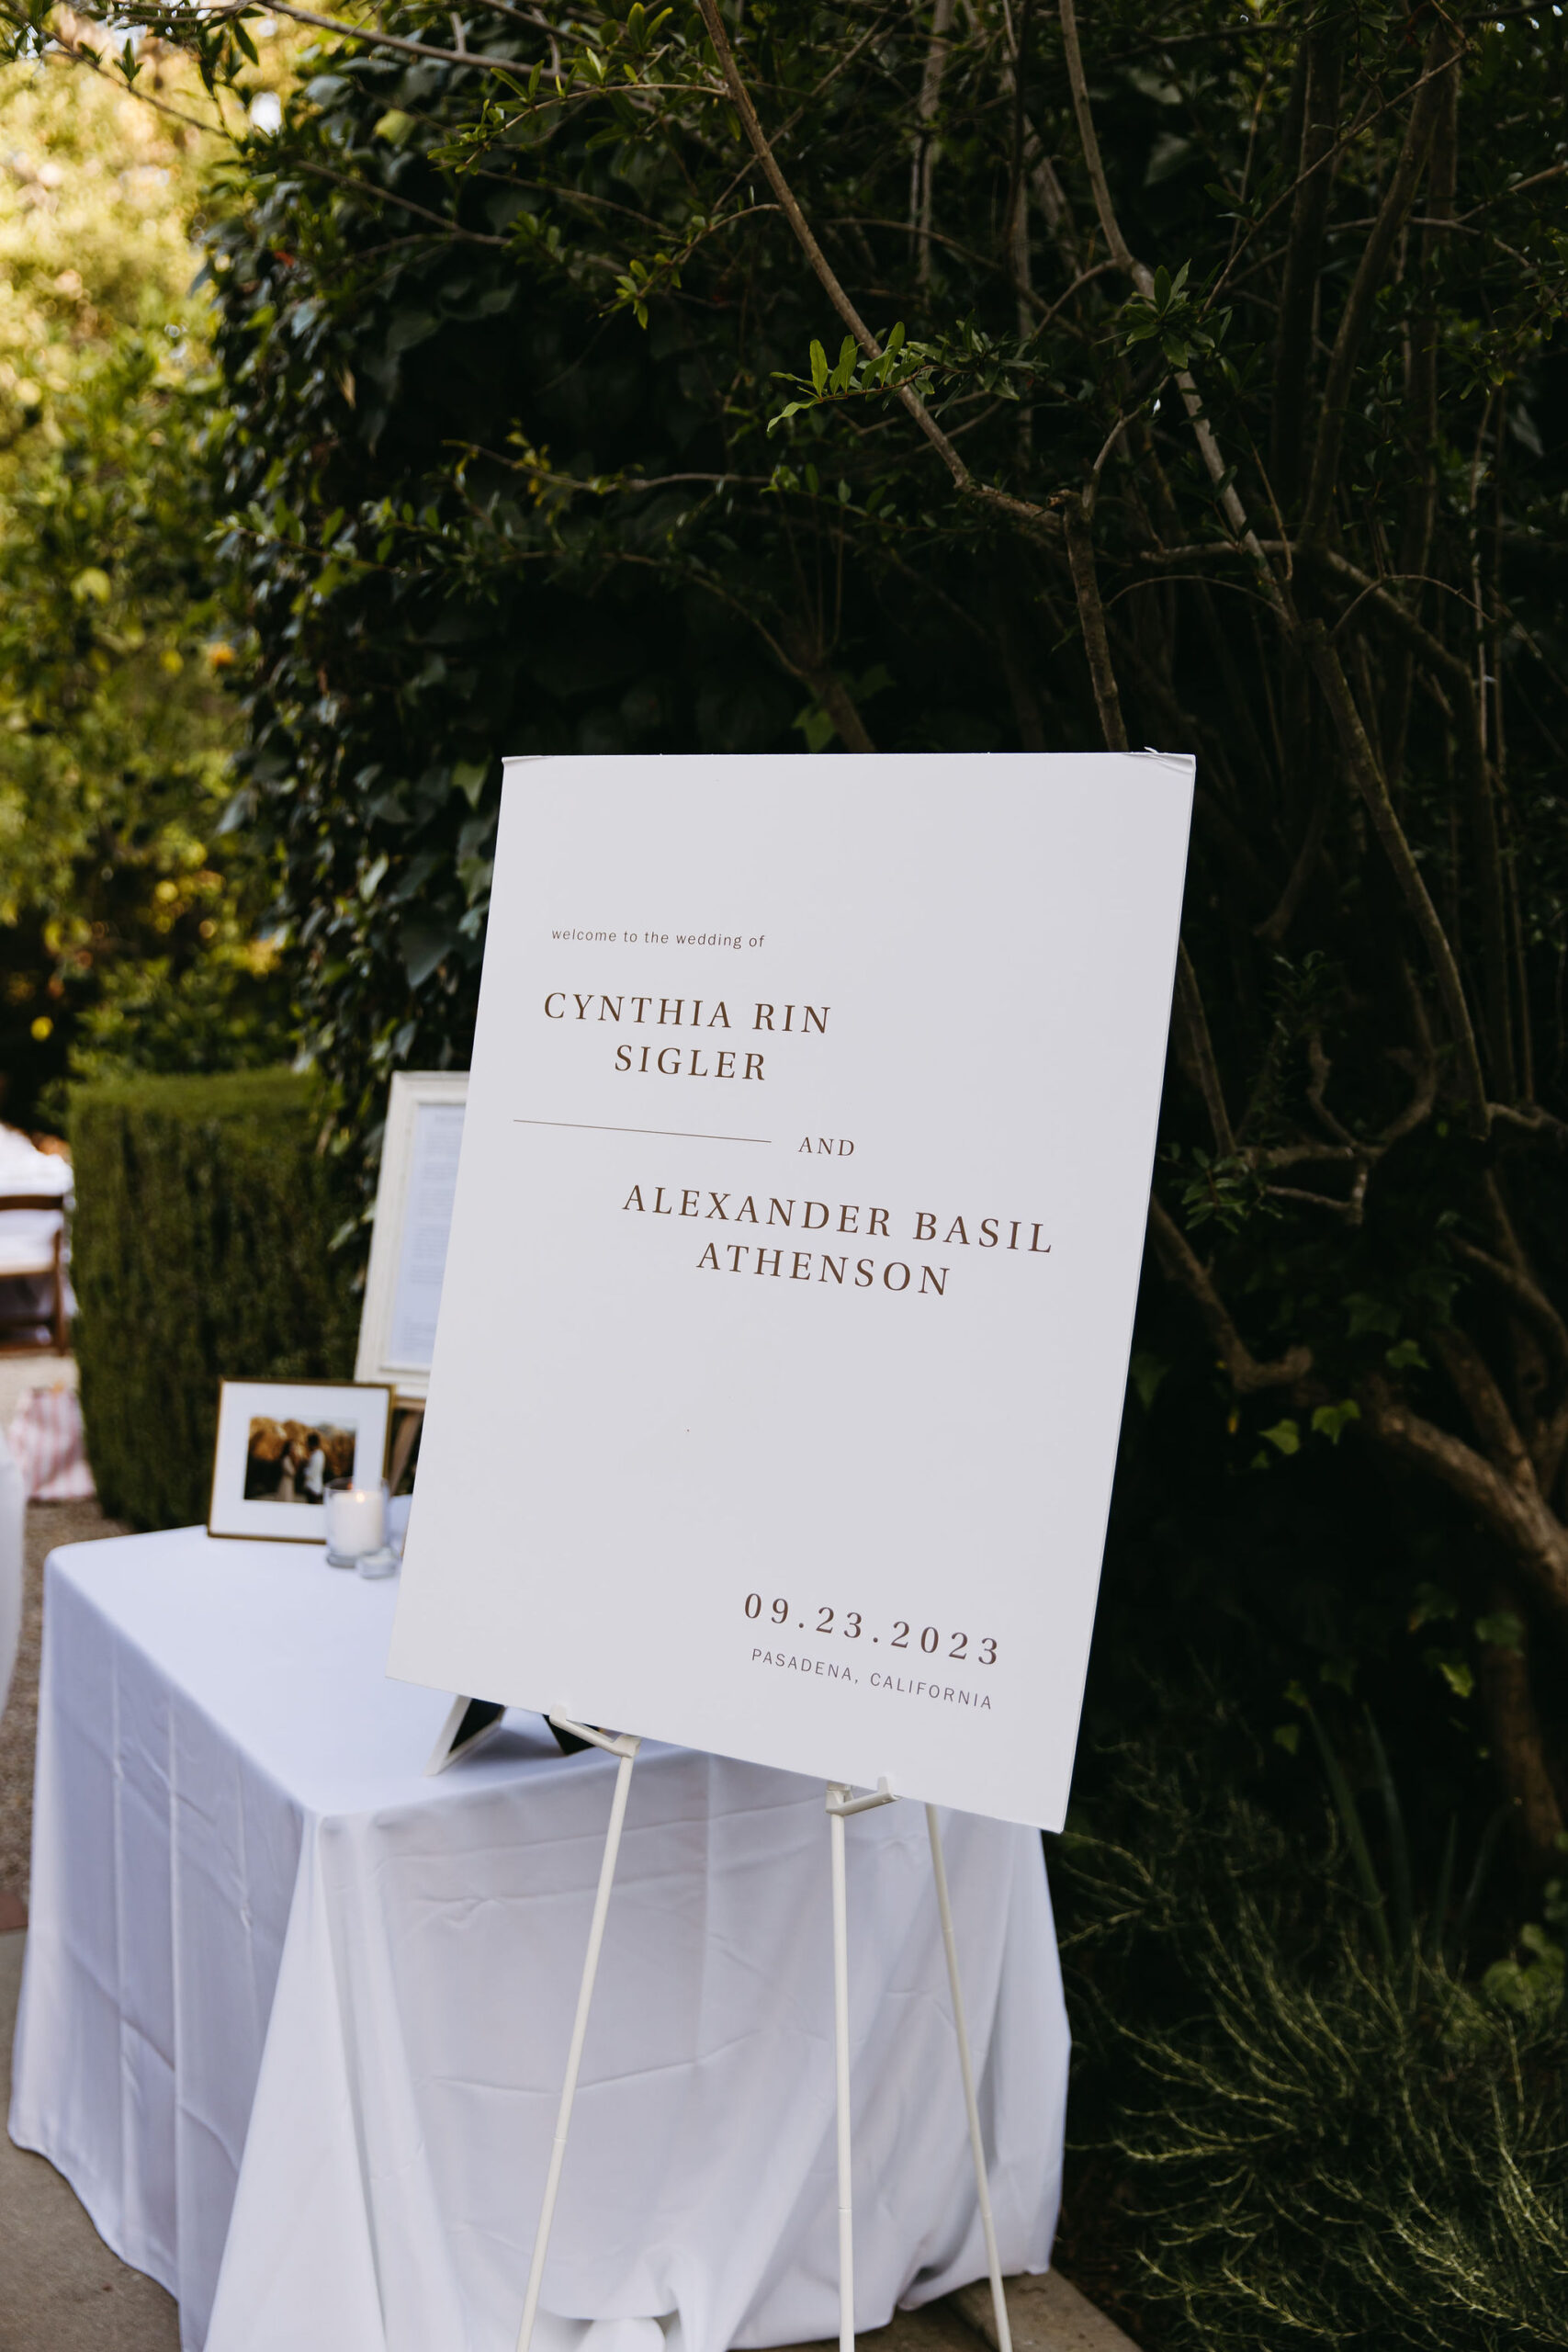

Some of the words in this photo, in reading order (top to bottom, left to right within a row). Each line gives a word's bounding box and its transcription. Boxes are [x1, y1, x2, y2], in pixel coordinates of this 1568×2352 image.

[551, 927, 618, 944] welcome
[623, 929, 639, 944] to
[644, 930, 671, 945] the
[675, 932, 743, 951] wedding
[749, 933, 766, 949] of
[544, 991, 732, 1029] CYNTHIA
[751, 1002, 831, 1035] RIN
[615, 1044, 765, 1081] SIGLER
[797, 1136, 855, 1157] AND
[621, 1184, 891, 1238] ALEXANDER
[911, 1211, 1052, 1254] BASIL
[694, 1242, 953, 1296] ATHENSON
[744, 1592, 998, 1666] 09.23.2023
[751, 1647, 859, 1685] PASADENA,
[870, 1672, 991, 1711] CALIFORNIA
